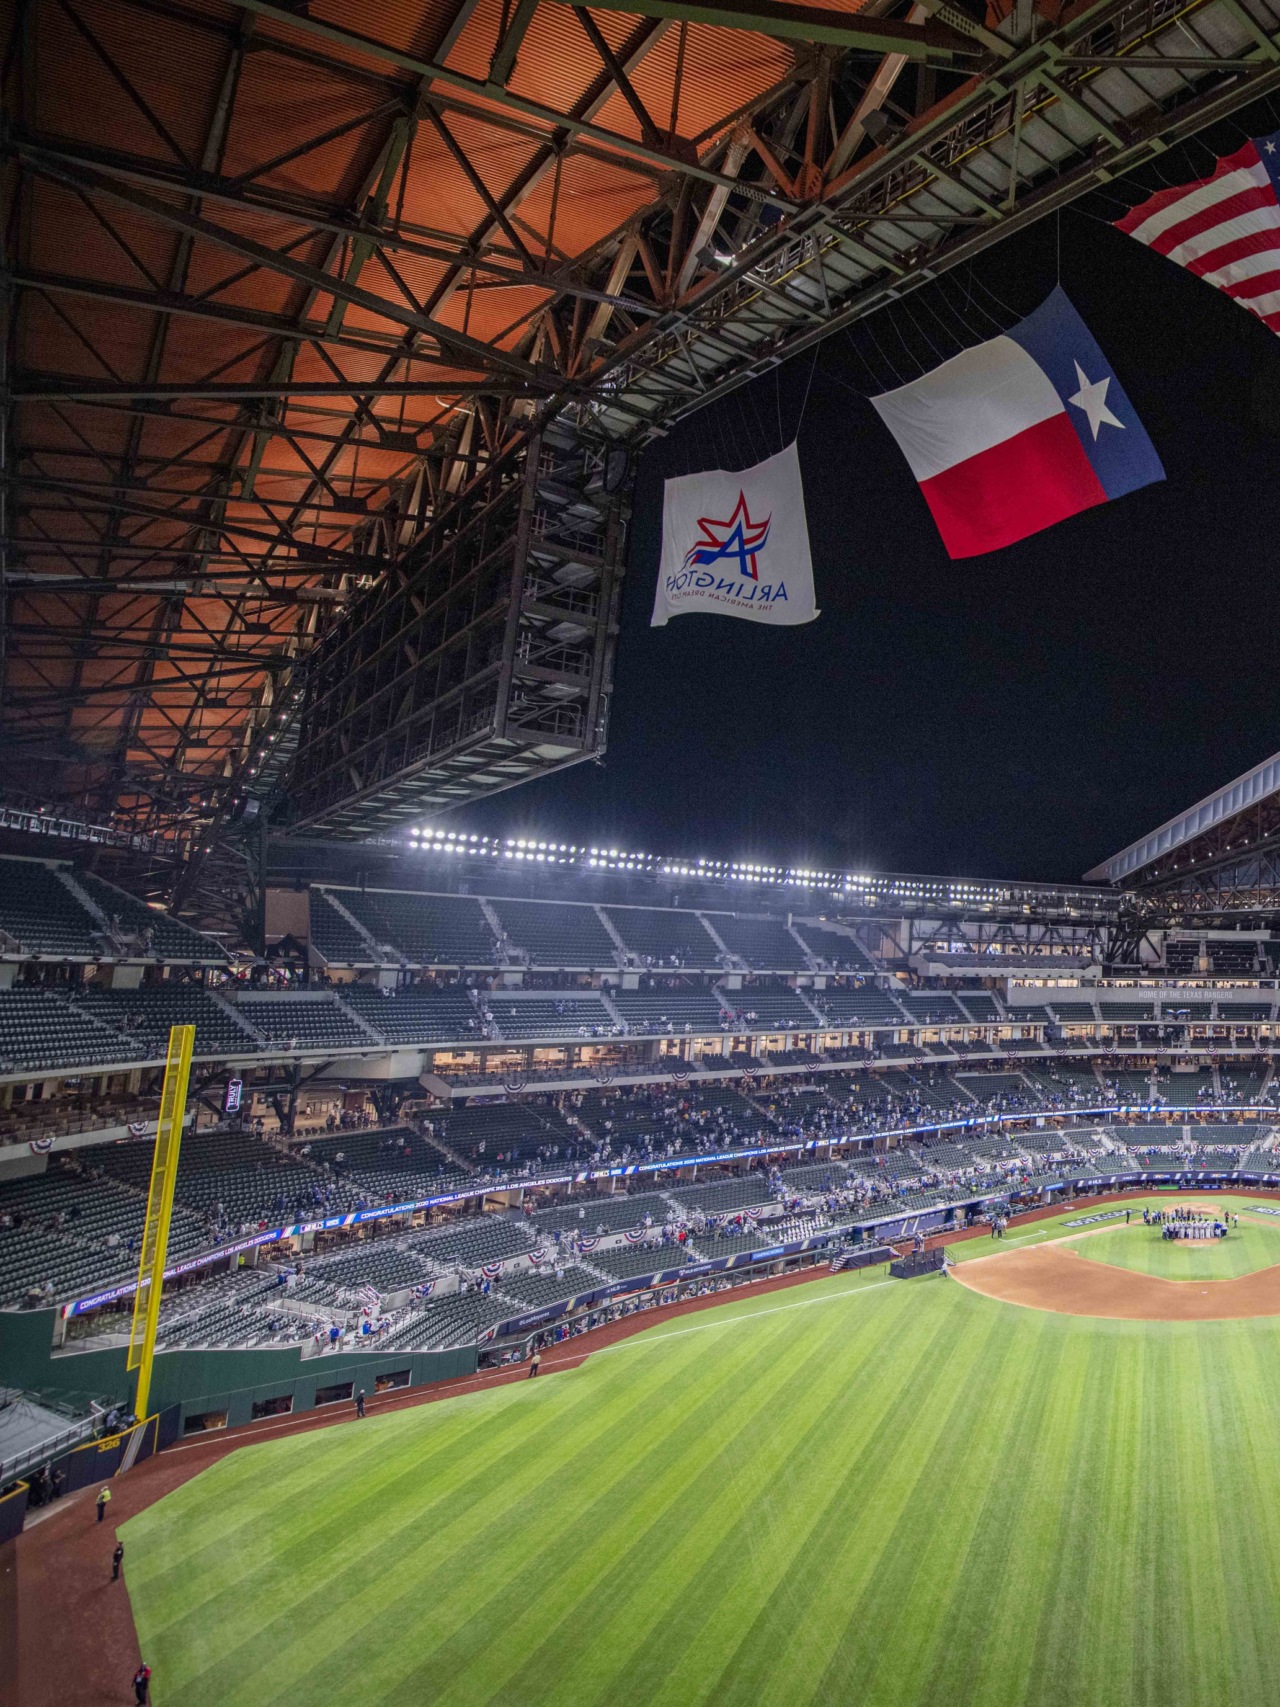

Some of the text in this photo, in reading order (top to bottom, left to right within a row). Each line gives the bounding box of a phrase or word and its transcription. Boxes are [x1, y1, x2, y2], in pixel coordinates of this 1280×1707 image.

[361, 1204, 414, 1219] CONGRATULATIONS
[415, 1200, 429, 1208] 2020
[429, 1195, 455, 1205] NATIONAL
[455, 1191, 474, 1199] LEAGUE
[520, 1180, 545, 1188] ANGELES
[546, 1176, 572, 1184] DODGERS
[80, 1282, 137, 1309] CONGRATULATIONS
[162, 1270, 176, 1279] ONAL
[177, 1261, 196, 1273] LEAGUE
[197, 1250, 225, 1265] CHAMPIONS
[225, 1247, 234, 1255] LOS
[234, 1240, 253, 1252] ANGELES
[254, 1232, 277, 1245] DODGERS
[98, 1438, 120, 1453] 326
